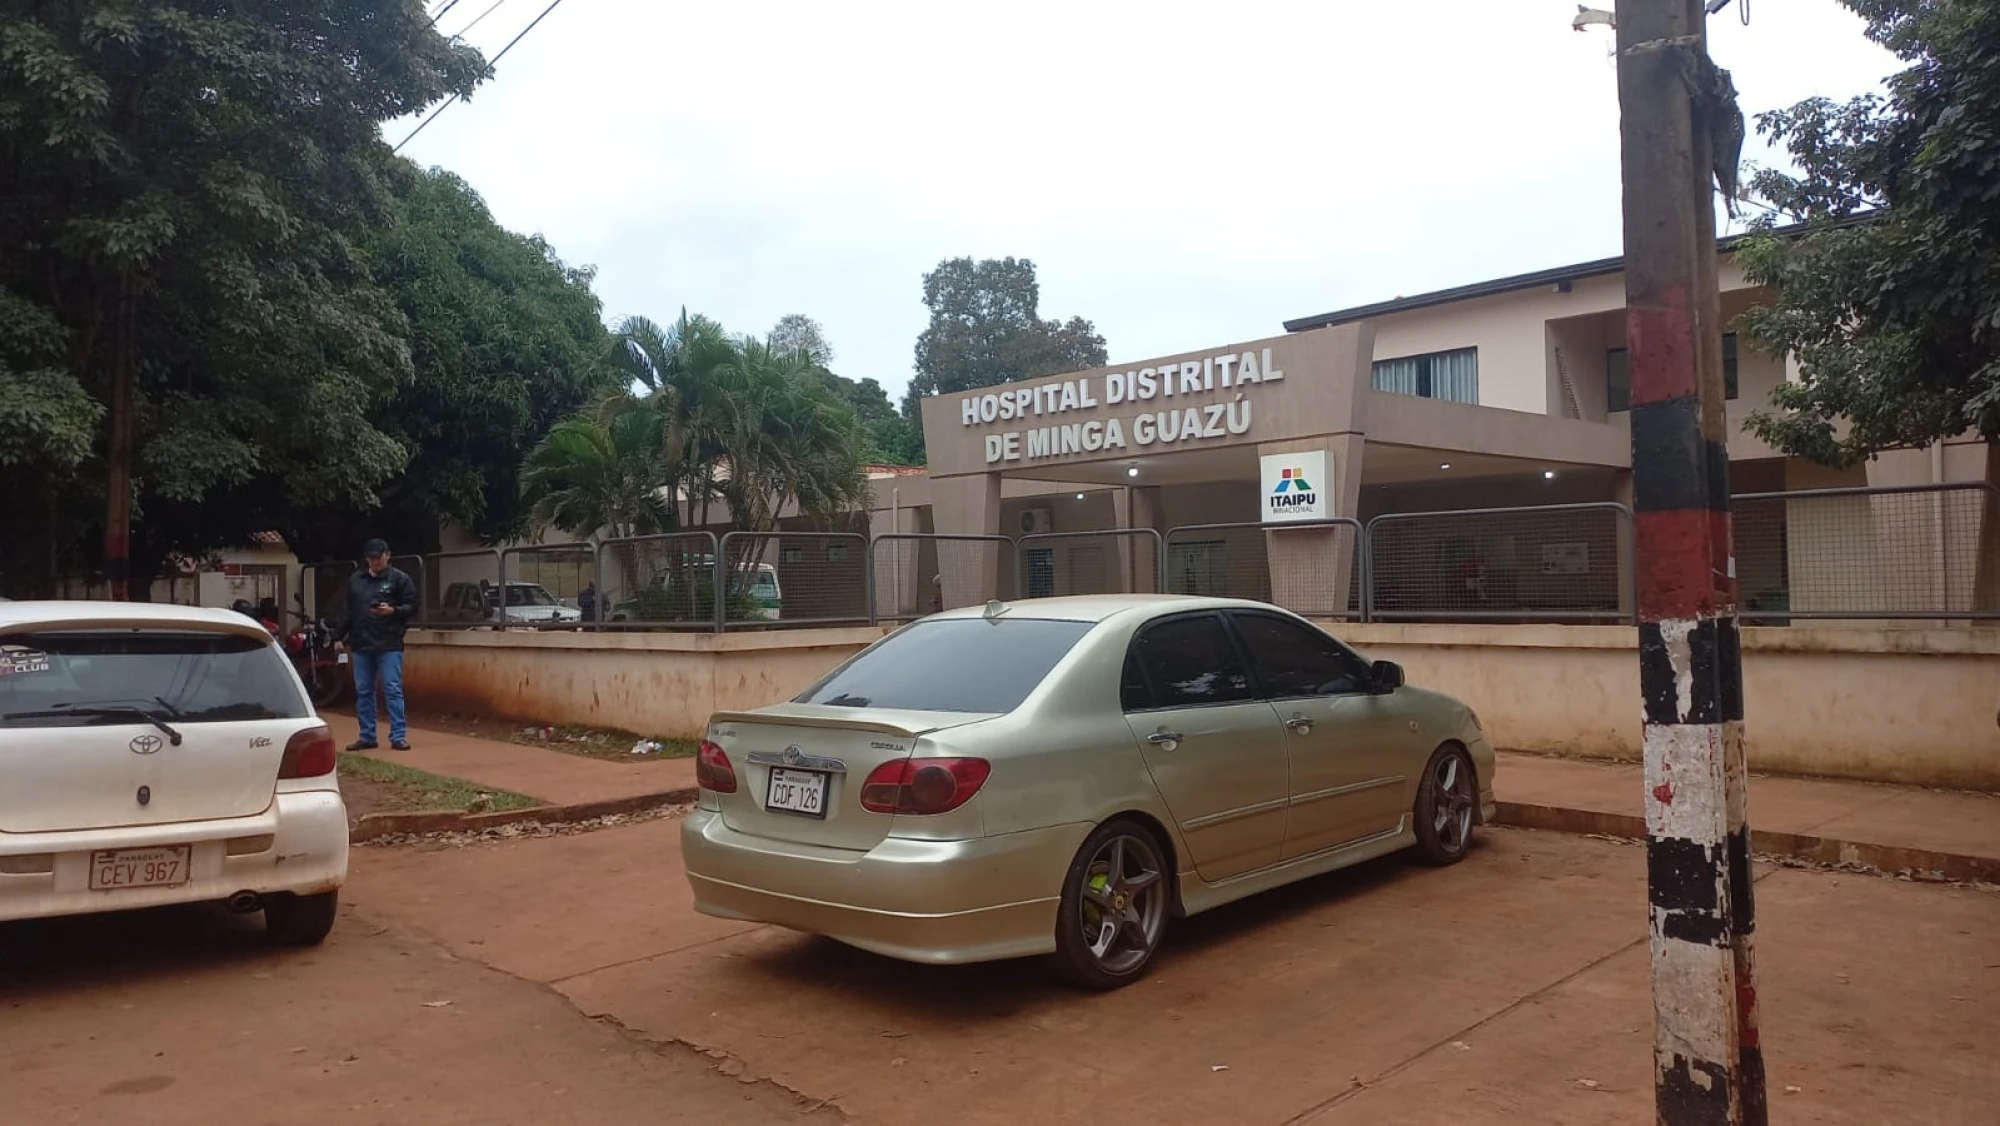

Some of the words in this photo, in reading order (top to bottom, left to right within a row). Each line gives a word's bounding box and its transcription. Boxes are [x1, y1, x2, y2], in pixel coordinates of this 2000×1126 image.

[962, 379, 1097, 425] HOSPITAL
[1106, 349, 1284, 404] DISTRITAL
[985, 432, 1020, 462] DE
[1027, 419, 1125, 458] MINGA
[1134, 393, 1251, 444] GUAZÚ
[1271, 493, 1316, 507] ITAIPU
[773, 783, 796, 806] CDF
[799, 786, 818, 809] 126
[101, 864, 137, 885] CEV
[143, 860, 179, 882] 967
